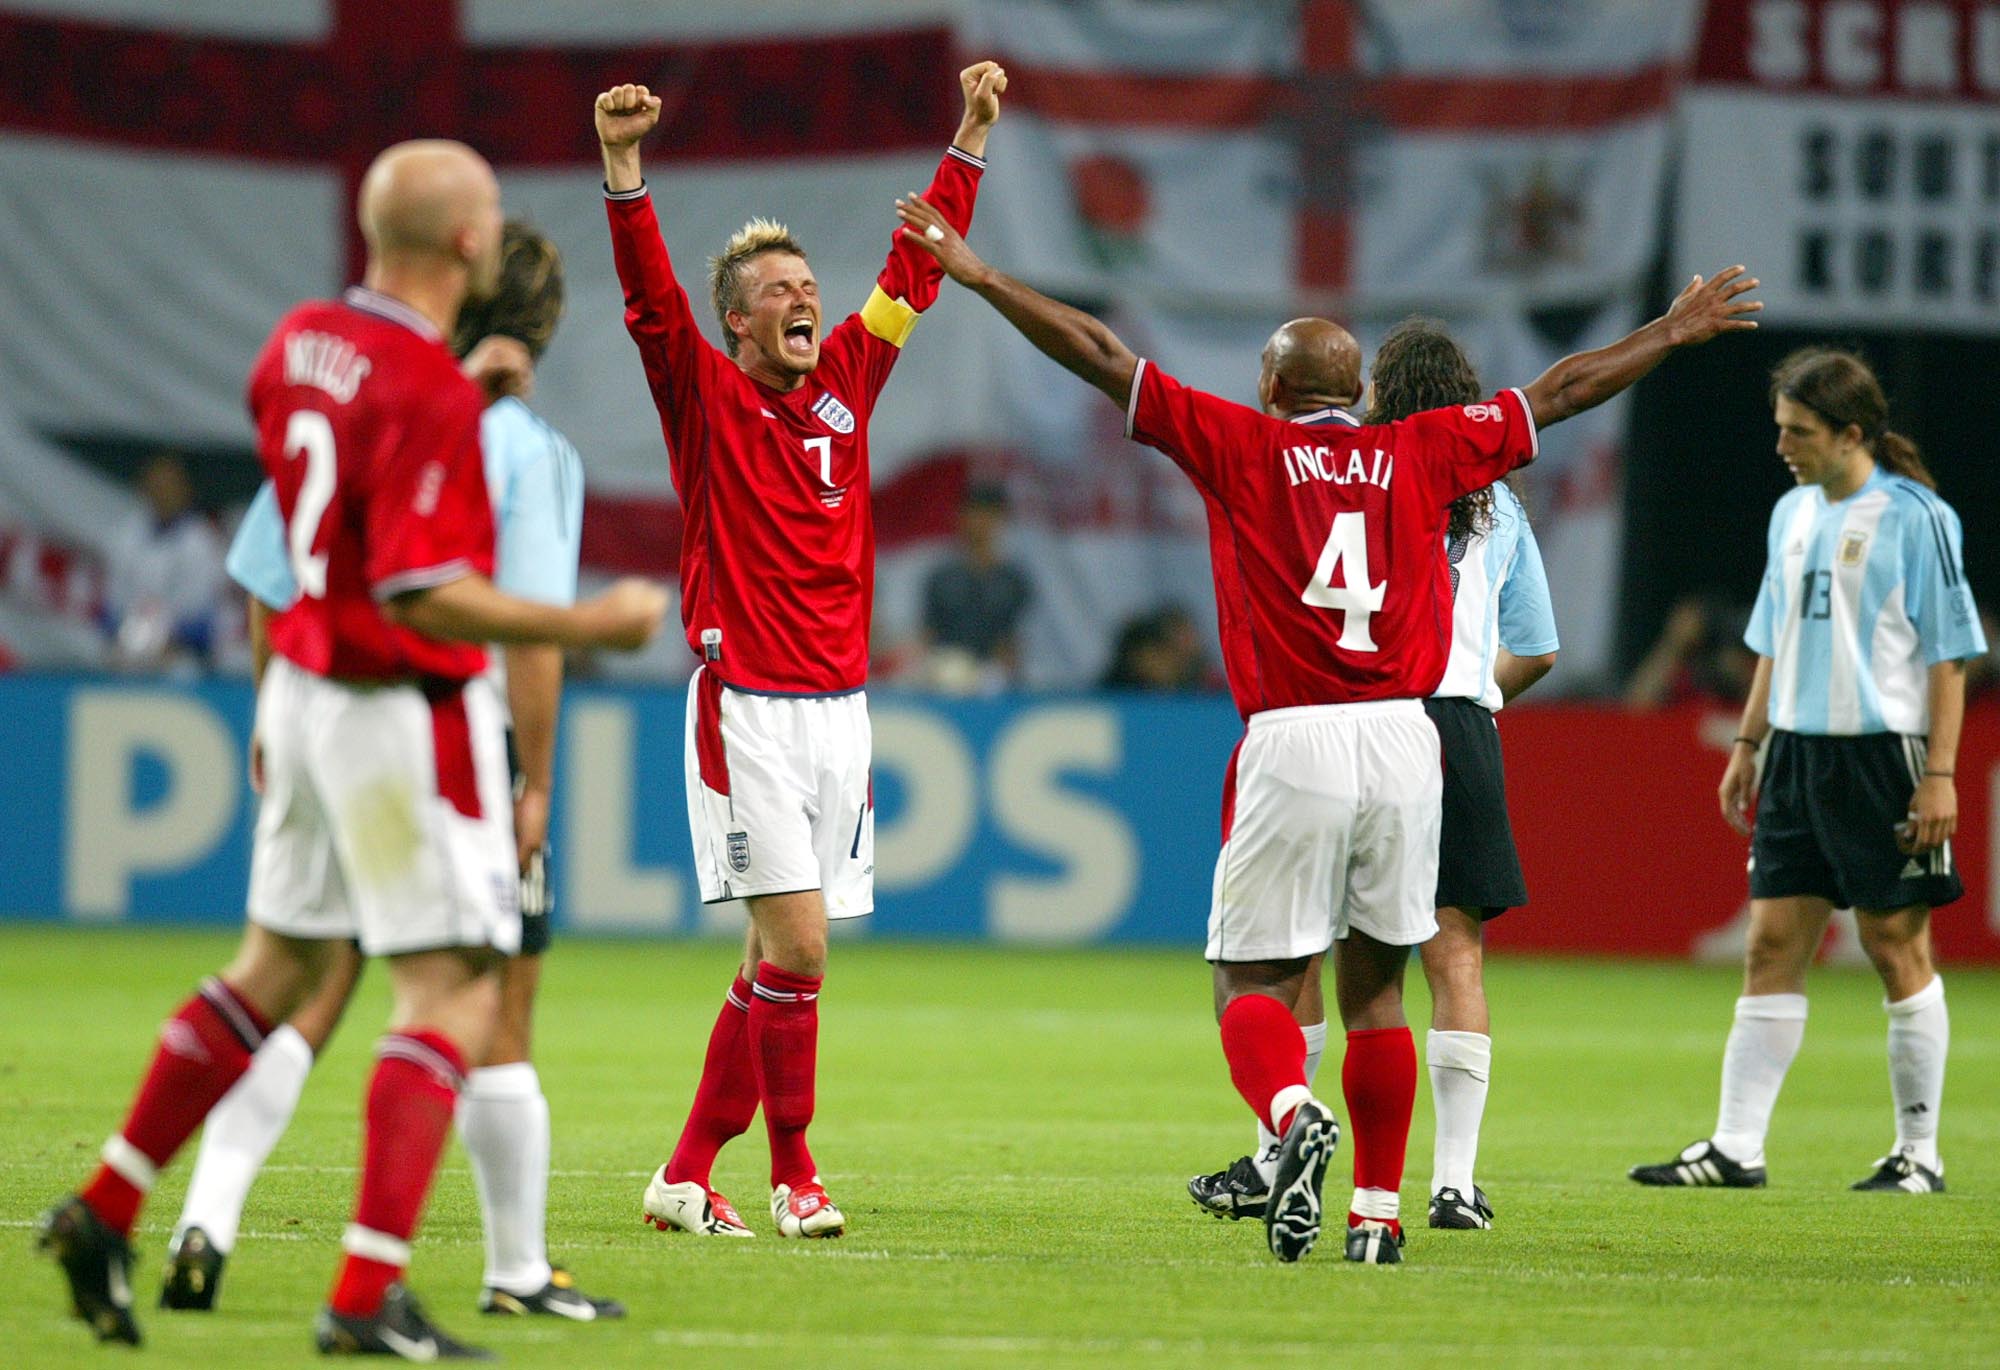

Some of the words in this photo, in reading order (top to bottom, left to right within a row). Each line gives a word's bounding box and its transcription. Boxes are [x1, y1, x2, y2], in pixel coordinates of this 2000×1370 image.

[803, 436, 836, 487] 7
[283, 408, 337, 599] 2
[1301, 511, 1388, 652] 4
[1801, 569, 1832, 619] 13
[677, 1200, 687, 1213] 7
